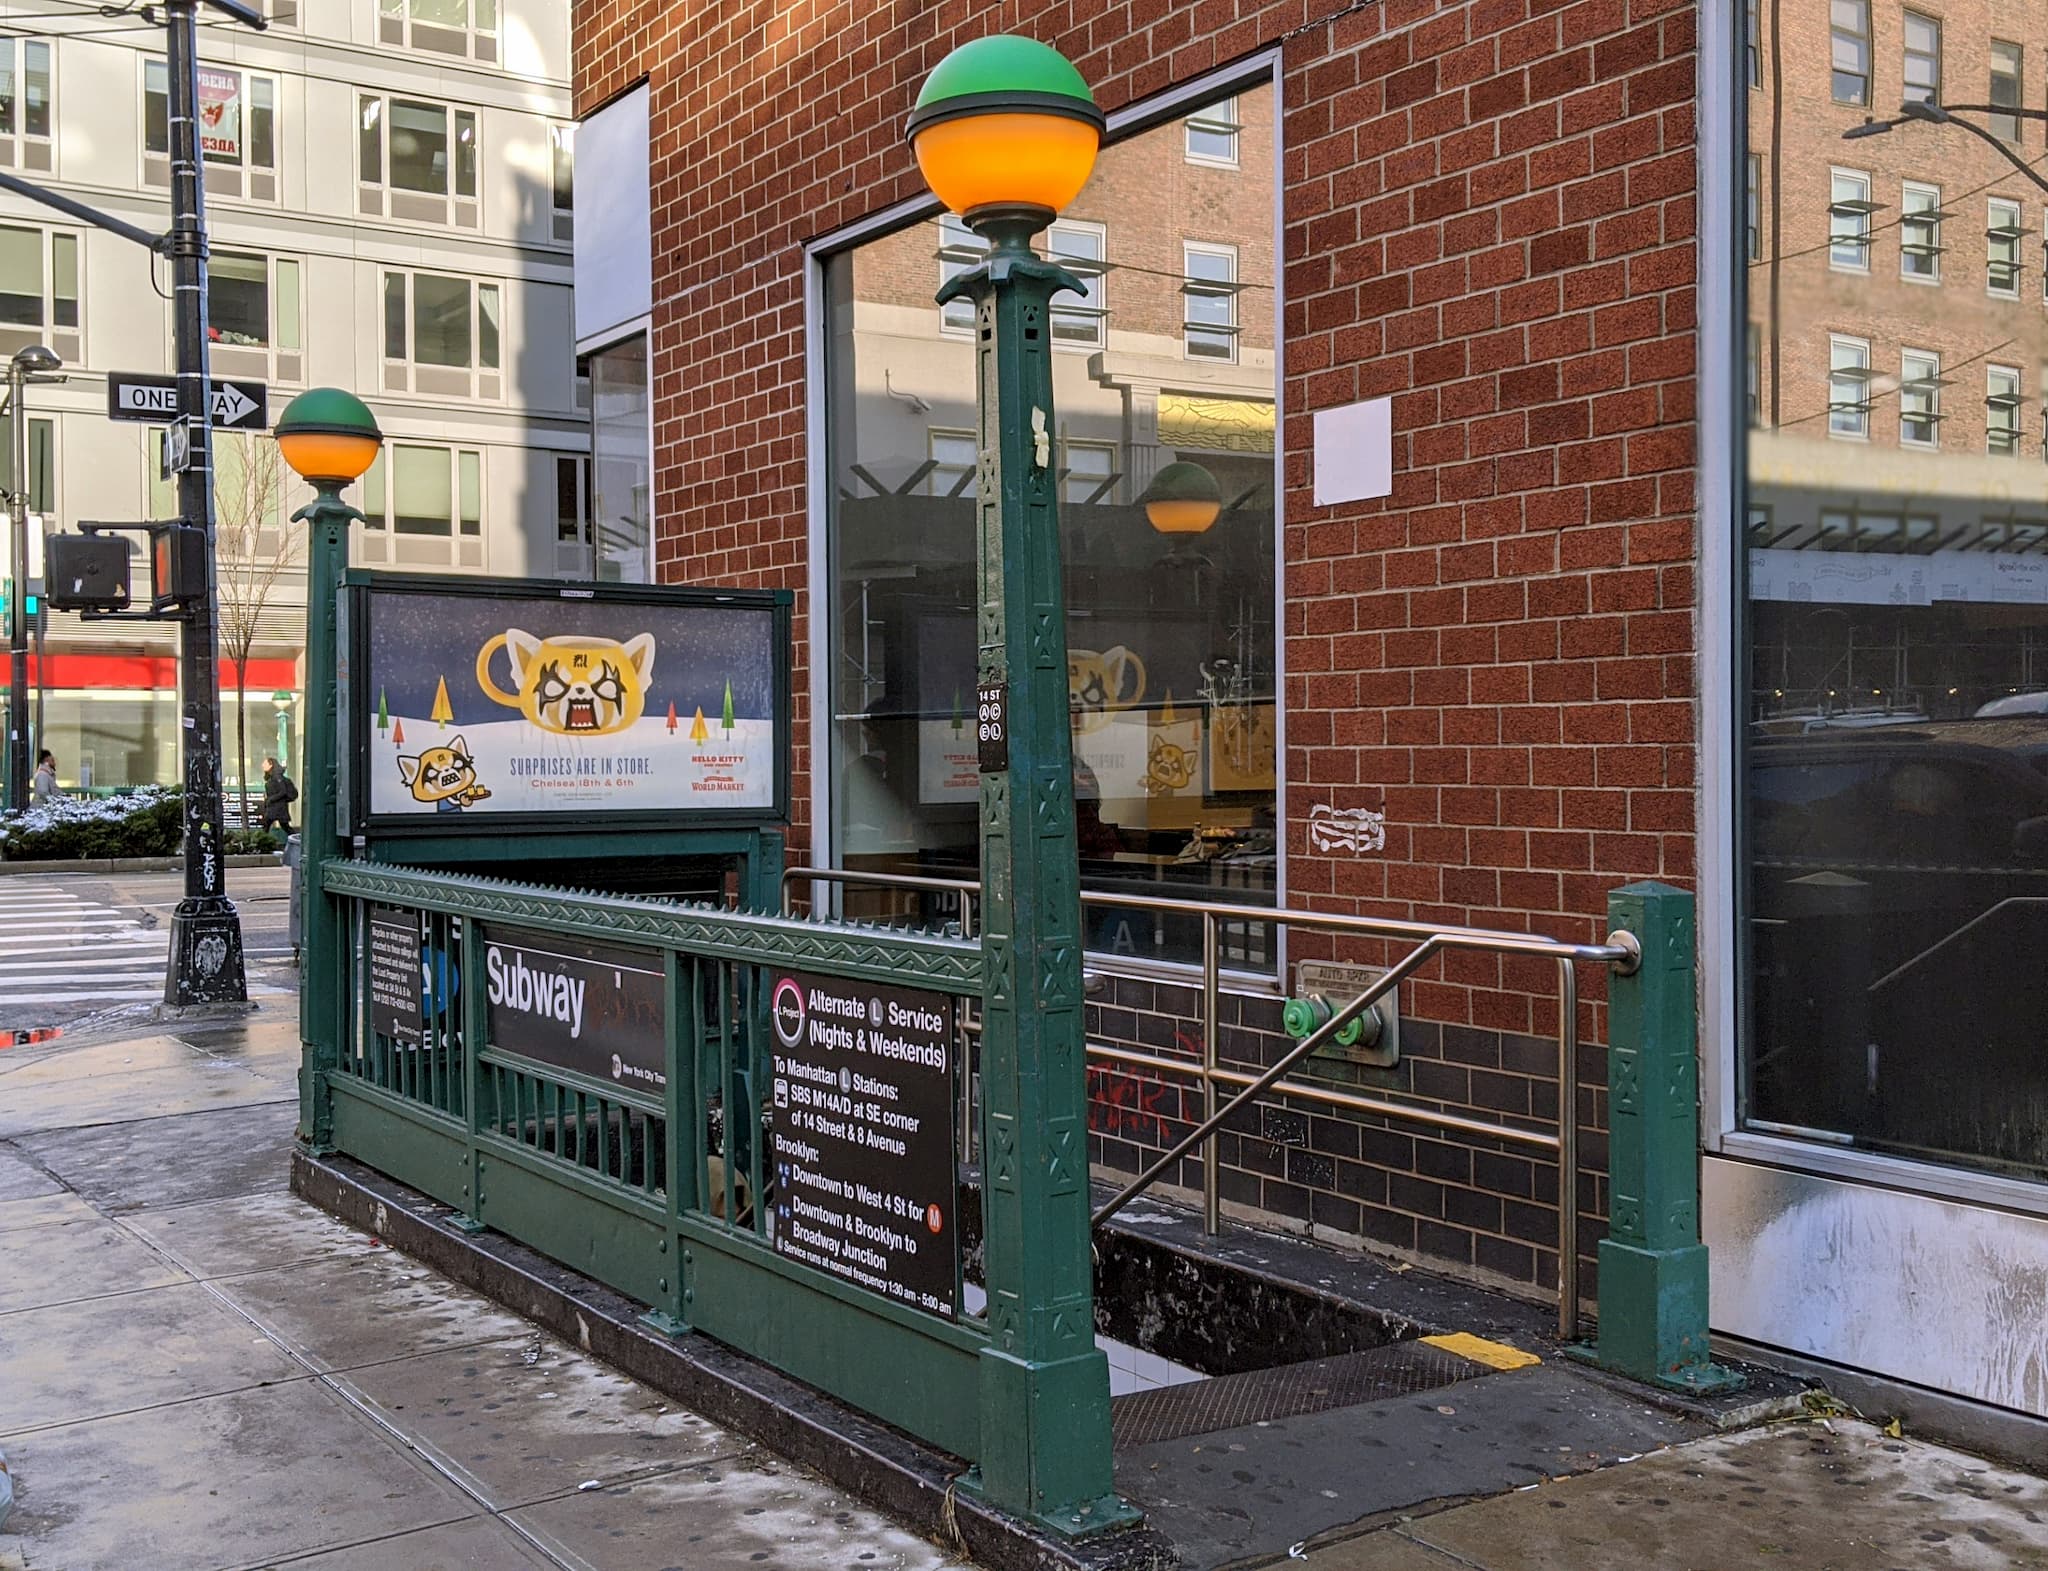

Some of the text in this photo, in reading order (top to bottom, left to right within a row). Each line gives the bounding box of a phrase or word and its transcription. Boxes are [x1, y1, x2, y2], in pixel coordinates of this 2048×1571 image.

[133, 390, 242, 413] ONE AY
[980, 690, 1000, 701] 14 ST
[511, 758, 653, 775] SURPRISES ARE IN STORE.
[532, 779, 575, 787] Chelsea
[579, 779, 600, 787] 18th
[617, 778, 633, 786] 6th
[487, 946, 586, 1038] Subway
[808, 988, 865, 1020] Alternate
[888, 1001, 943, 1033] Service
[809, 1020, 946, 1073] (Nights & Weekends)
[774, 1055, 785, 1073] To
[788, 1058, 837, 1085] Manhattan
[853, 1074, 898, 1100] Stations:
[791, 1084, 919, 1133] SBS M14A/D at SE corner
[776, 1133, 819, 1162] Brooklyn:
[791, 1111, 905, 1156] of 14 Street & 8 Avenue
[793, 1164, 842, 1197] Downtown
[844, 1181, 854, 1199] to
[856, 1184, 882, 1208] West
[884, 1193, 892, 1209] 4
[894, 1196, 905, 1214] St
[908, 1201, 924, 1222] for
[793, 1195, 917, 1254] Downtown & Brooklyn to
[793, 1222, 887, 1272] Broadway Junction
[784, 1241, 807, 1258] Service
[807, 1251, 821, 1264] runs
[822, 1256, 829, 1267] at
[830, 1261, 852, 1275] normal
[853, 1267, 887, 1292] frequency
[888, 1281, 903, 1295] 1:30
[904, 1289, 916, 1302] am
[922, 1293, 938, 1310] 5:00
[939, 1302, 952, 1315] am
